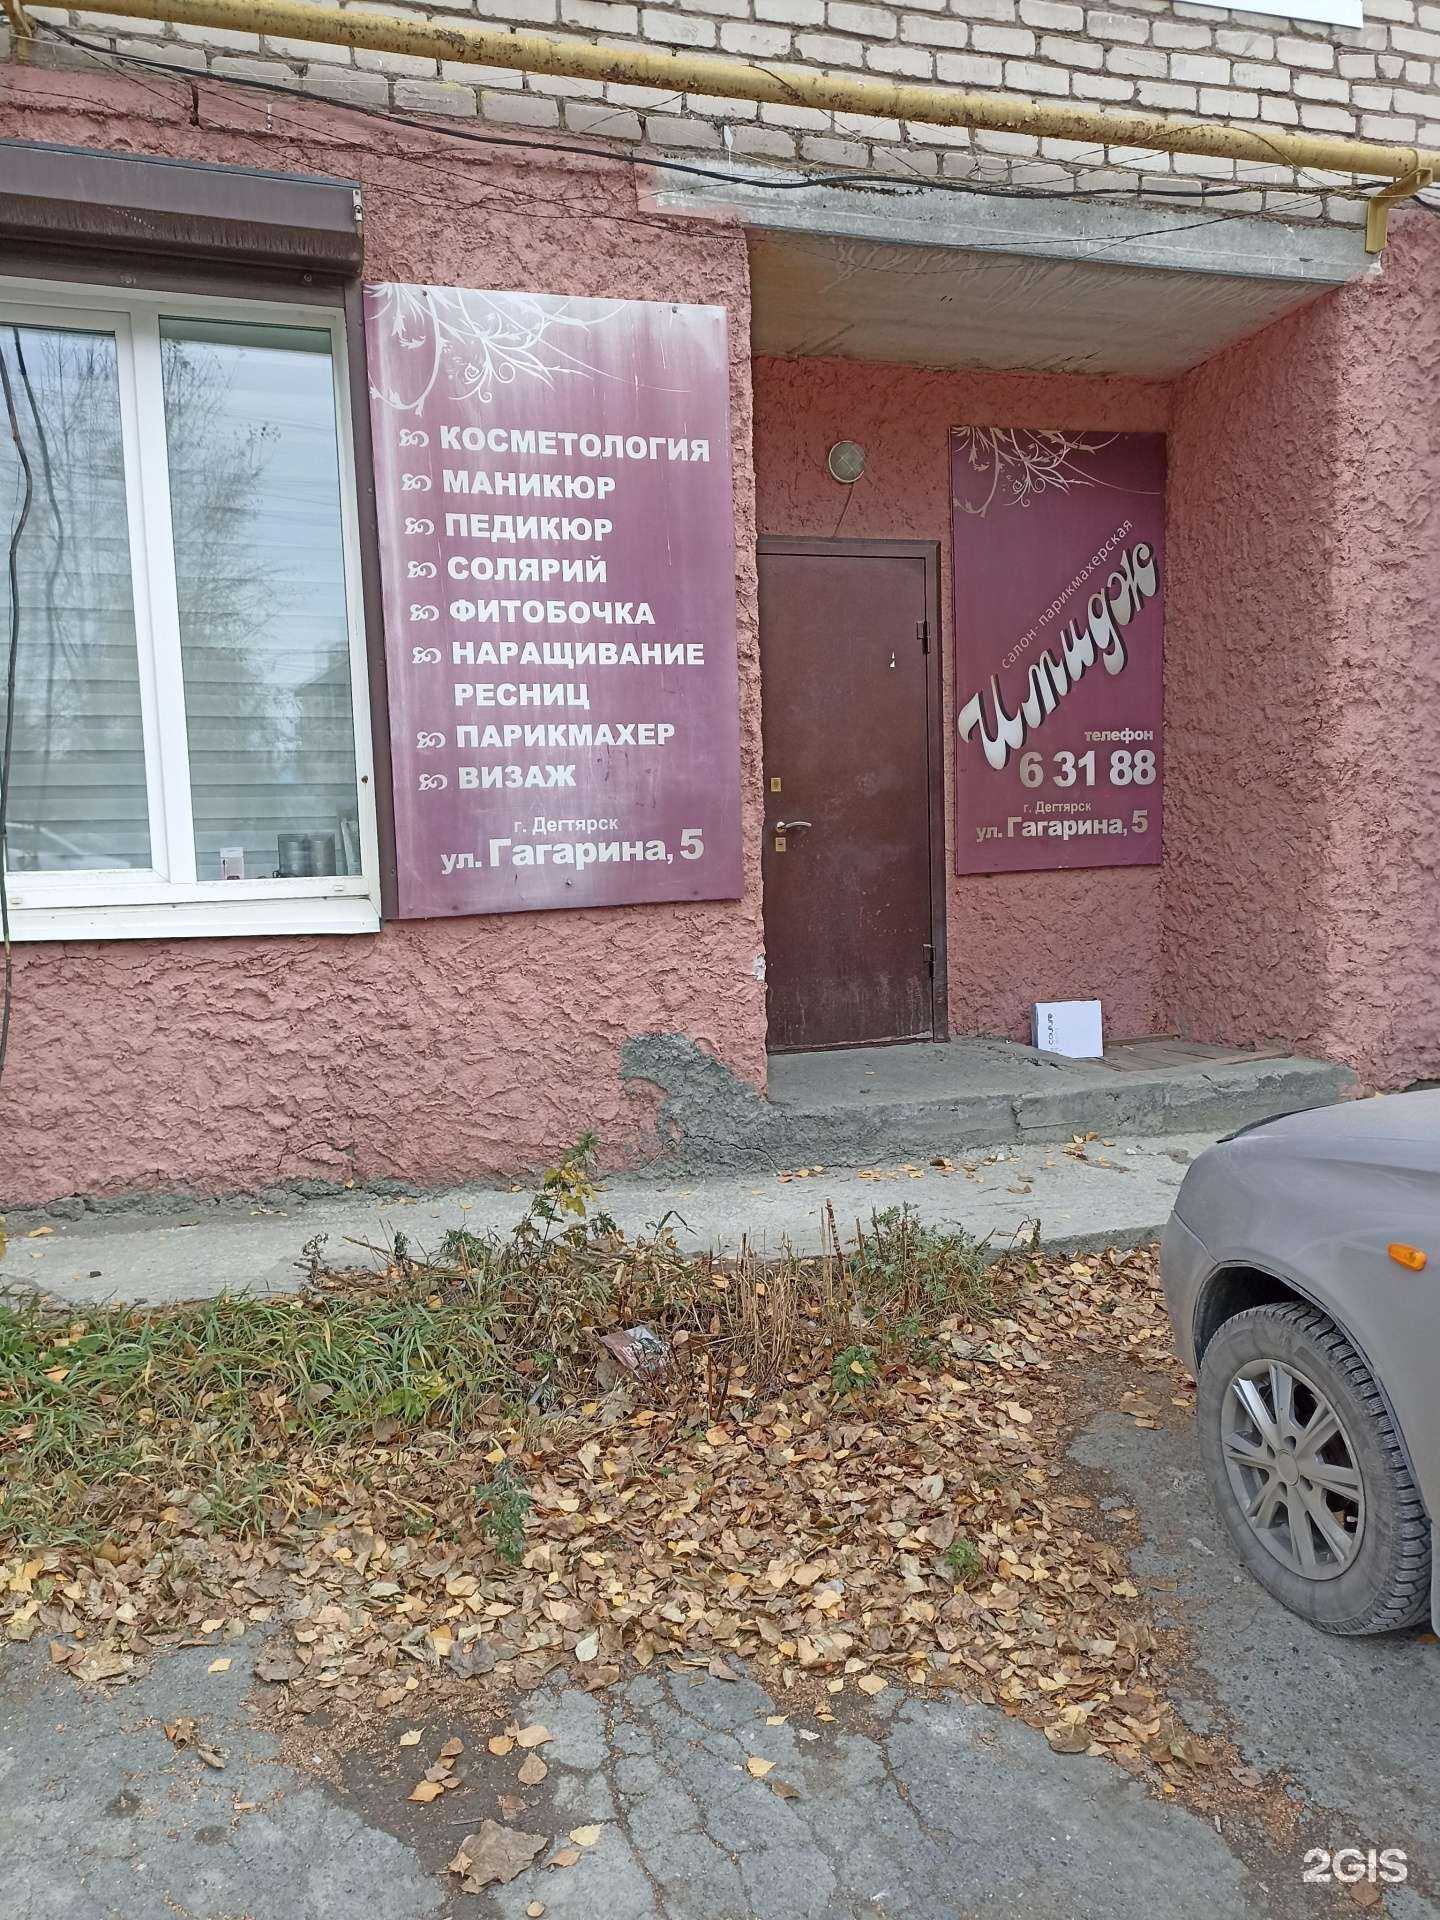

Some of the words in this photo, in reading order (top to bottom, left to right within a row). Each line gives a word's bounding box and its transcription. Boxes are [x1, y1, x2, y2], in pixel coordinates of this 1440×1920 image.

[440, 425, 710, 462] КОСМЕТОЛОГИЯ
[442, 469, 616, 500] МАНИКЮР
[445, 513, 613, 543] ПЕДИКЮР
[447, 555, 607, 582] СОЛЯРИЙ
[449, 599, 656, 625] ФИТОБОЧКА
[452, 641, 705, 669] НАРАЩИВАНИЕ
[454, 683, 590, 709] РЕСНИЦ
[456, 724, 675, 748] ПАРИКМАХЕР
[1085, 728, 1154, 743] телефон
[458, 764, 577, 789] ВИЗАЖ
[1019, 751, 1044, 788] 6
[1052, 750, 1096, 787] 31
[1109, 749, 1157, 786] 88
[1035, 801, 1092, 815] Дегтярск
[514, 821, 527, 833] г.
[532, 816, 619, 835] Дегтярск
[976, 825, 1003, 842] ул.
[1007, 817, 1128, 840] Гагарина,
[1131, 810, 1148, 833] 5
[440, 852, 482, 875] ул.
[489, 838, 674, 870] Гагарина,
[680, 828, 705, 860] 5
